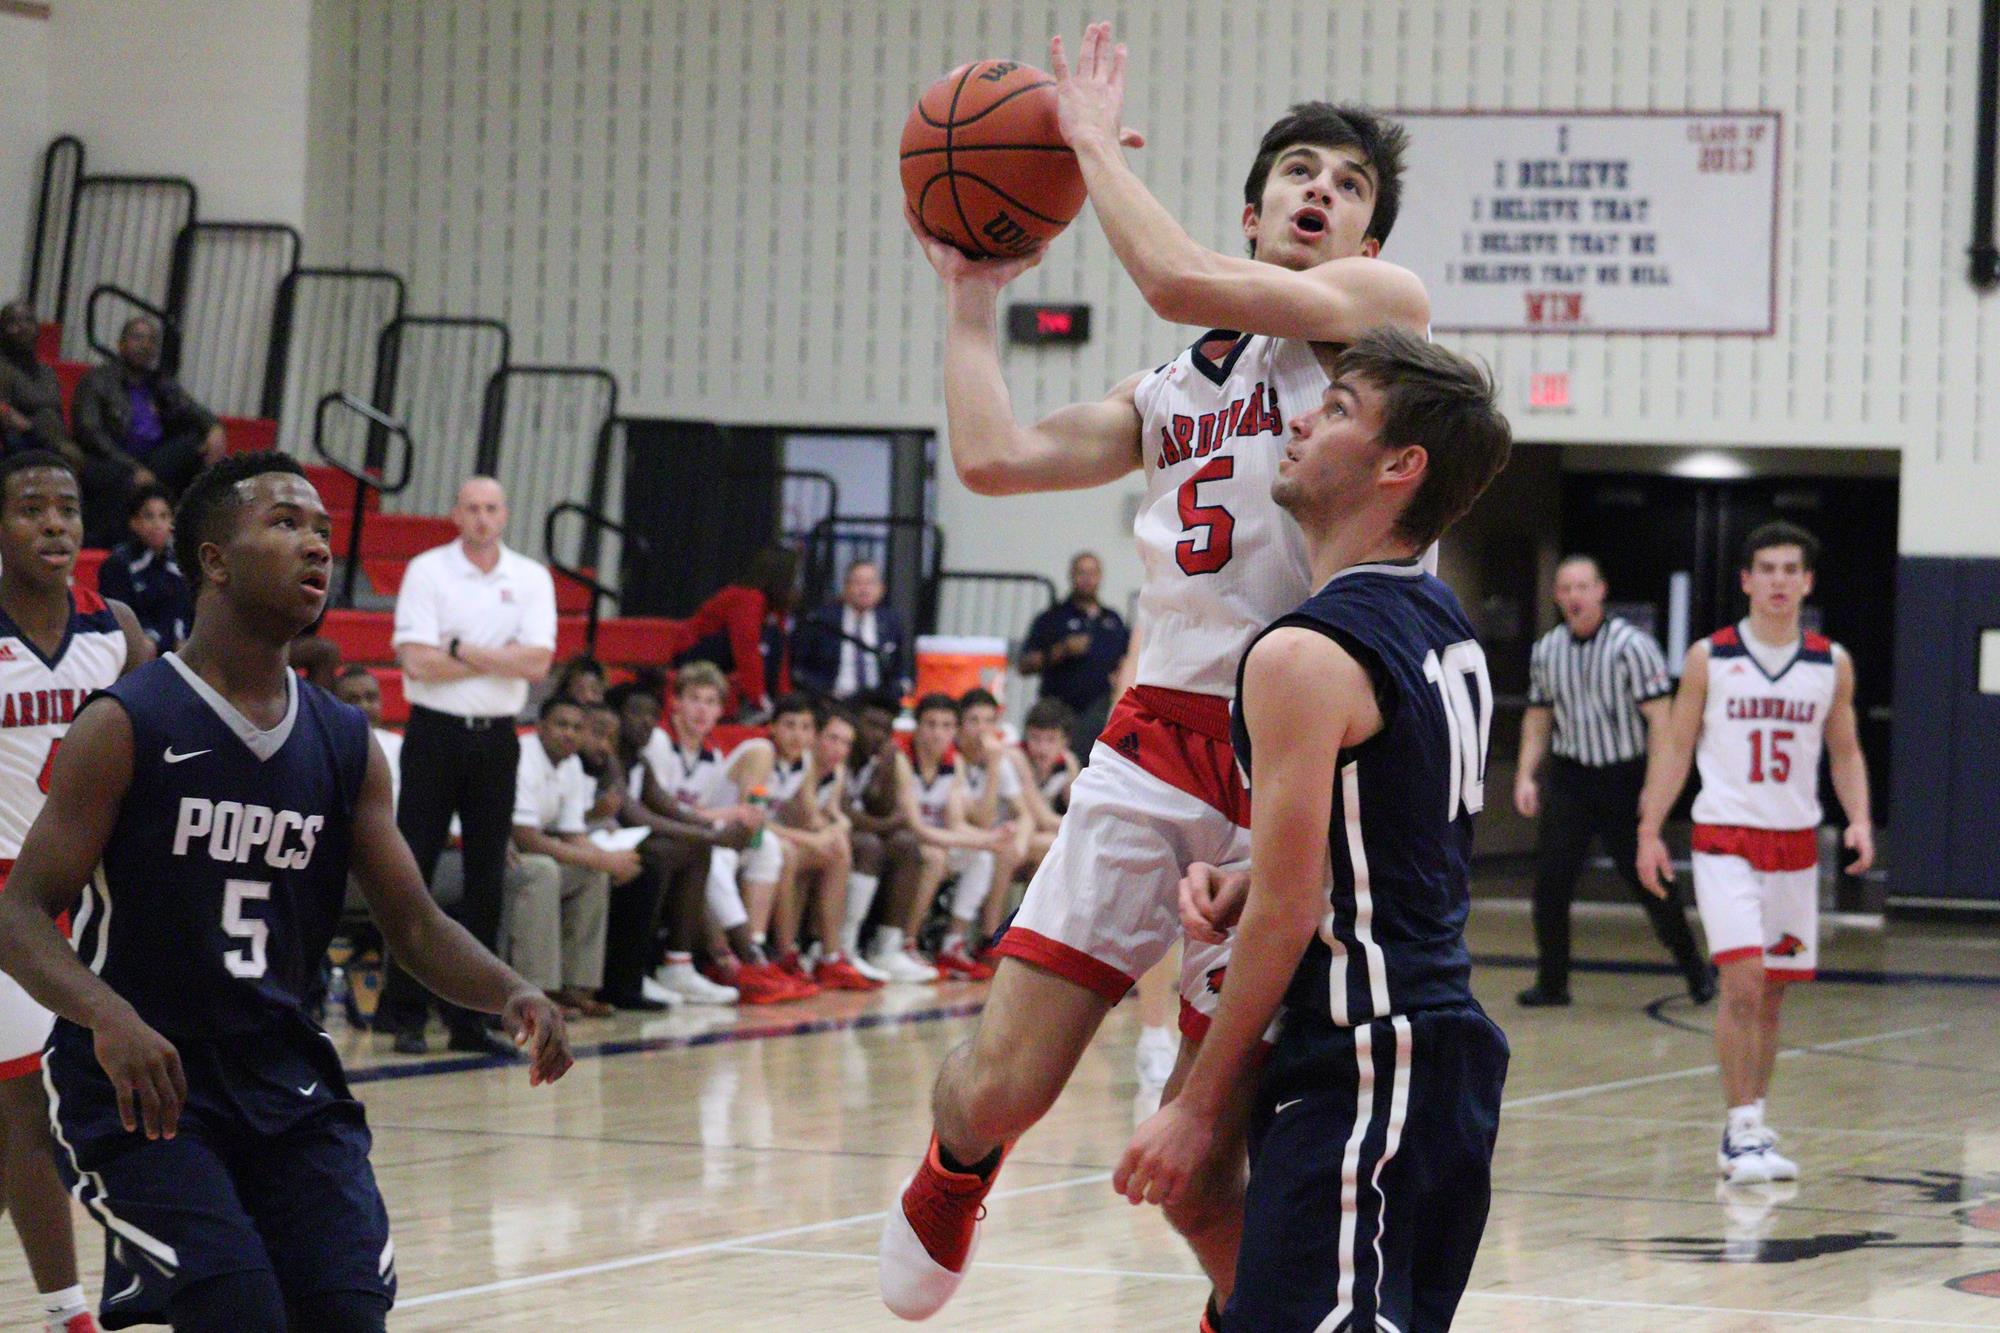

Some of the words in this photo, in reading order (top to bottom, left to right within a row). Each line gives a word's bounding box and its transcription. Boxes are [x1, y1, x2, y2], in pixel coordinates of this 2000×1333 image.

[1558, 125, 1569, 155] I
[1686, 123, 1737, 142] CLASS
[1745, 123, 1766, 142] OF
[1494, 160, 1506, 189] I
[1518, 160, 1628, 189] BELIEVE
[1472, 198, 1482, 222] I
[1492, 198, 1580, 222] BELIEVE
[1592, 198, 1649, 222] THAT
[1479, 231, 1559, 254] BELIEVE
[1568, 231, 1620, 254] THAT
[1630, 231, 1656, 254] WE
[1462, 262, 1532, 284] BELIEVE
[1541, 262, 1587, 284] THAT
[1596, 262, 1620, 284] WE
[1629, 262, 1672, 285] WILL
[1175, 455, 1236, 577] 5
[1726, 697, 1817, 723] CARDINALS
[1421, 638, 1495, 824] 10
[1748, 729, 1795, 783] 15
[171, 796, 325, 870] POPCS
[221, 878, 272, 979] 5
